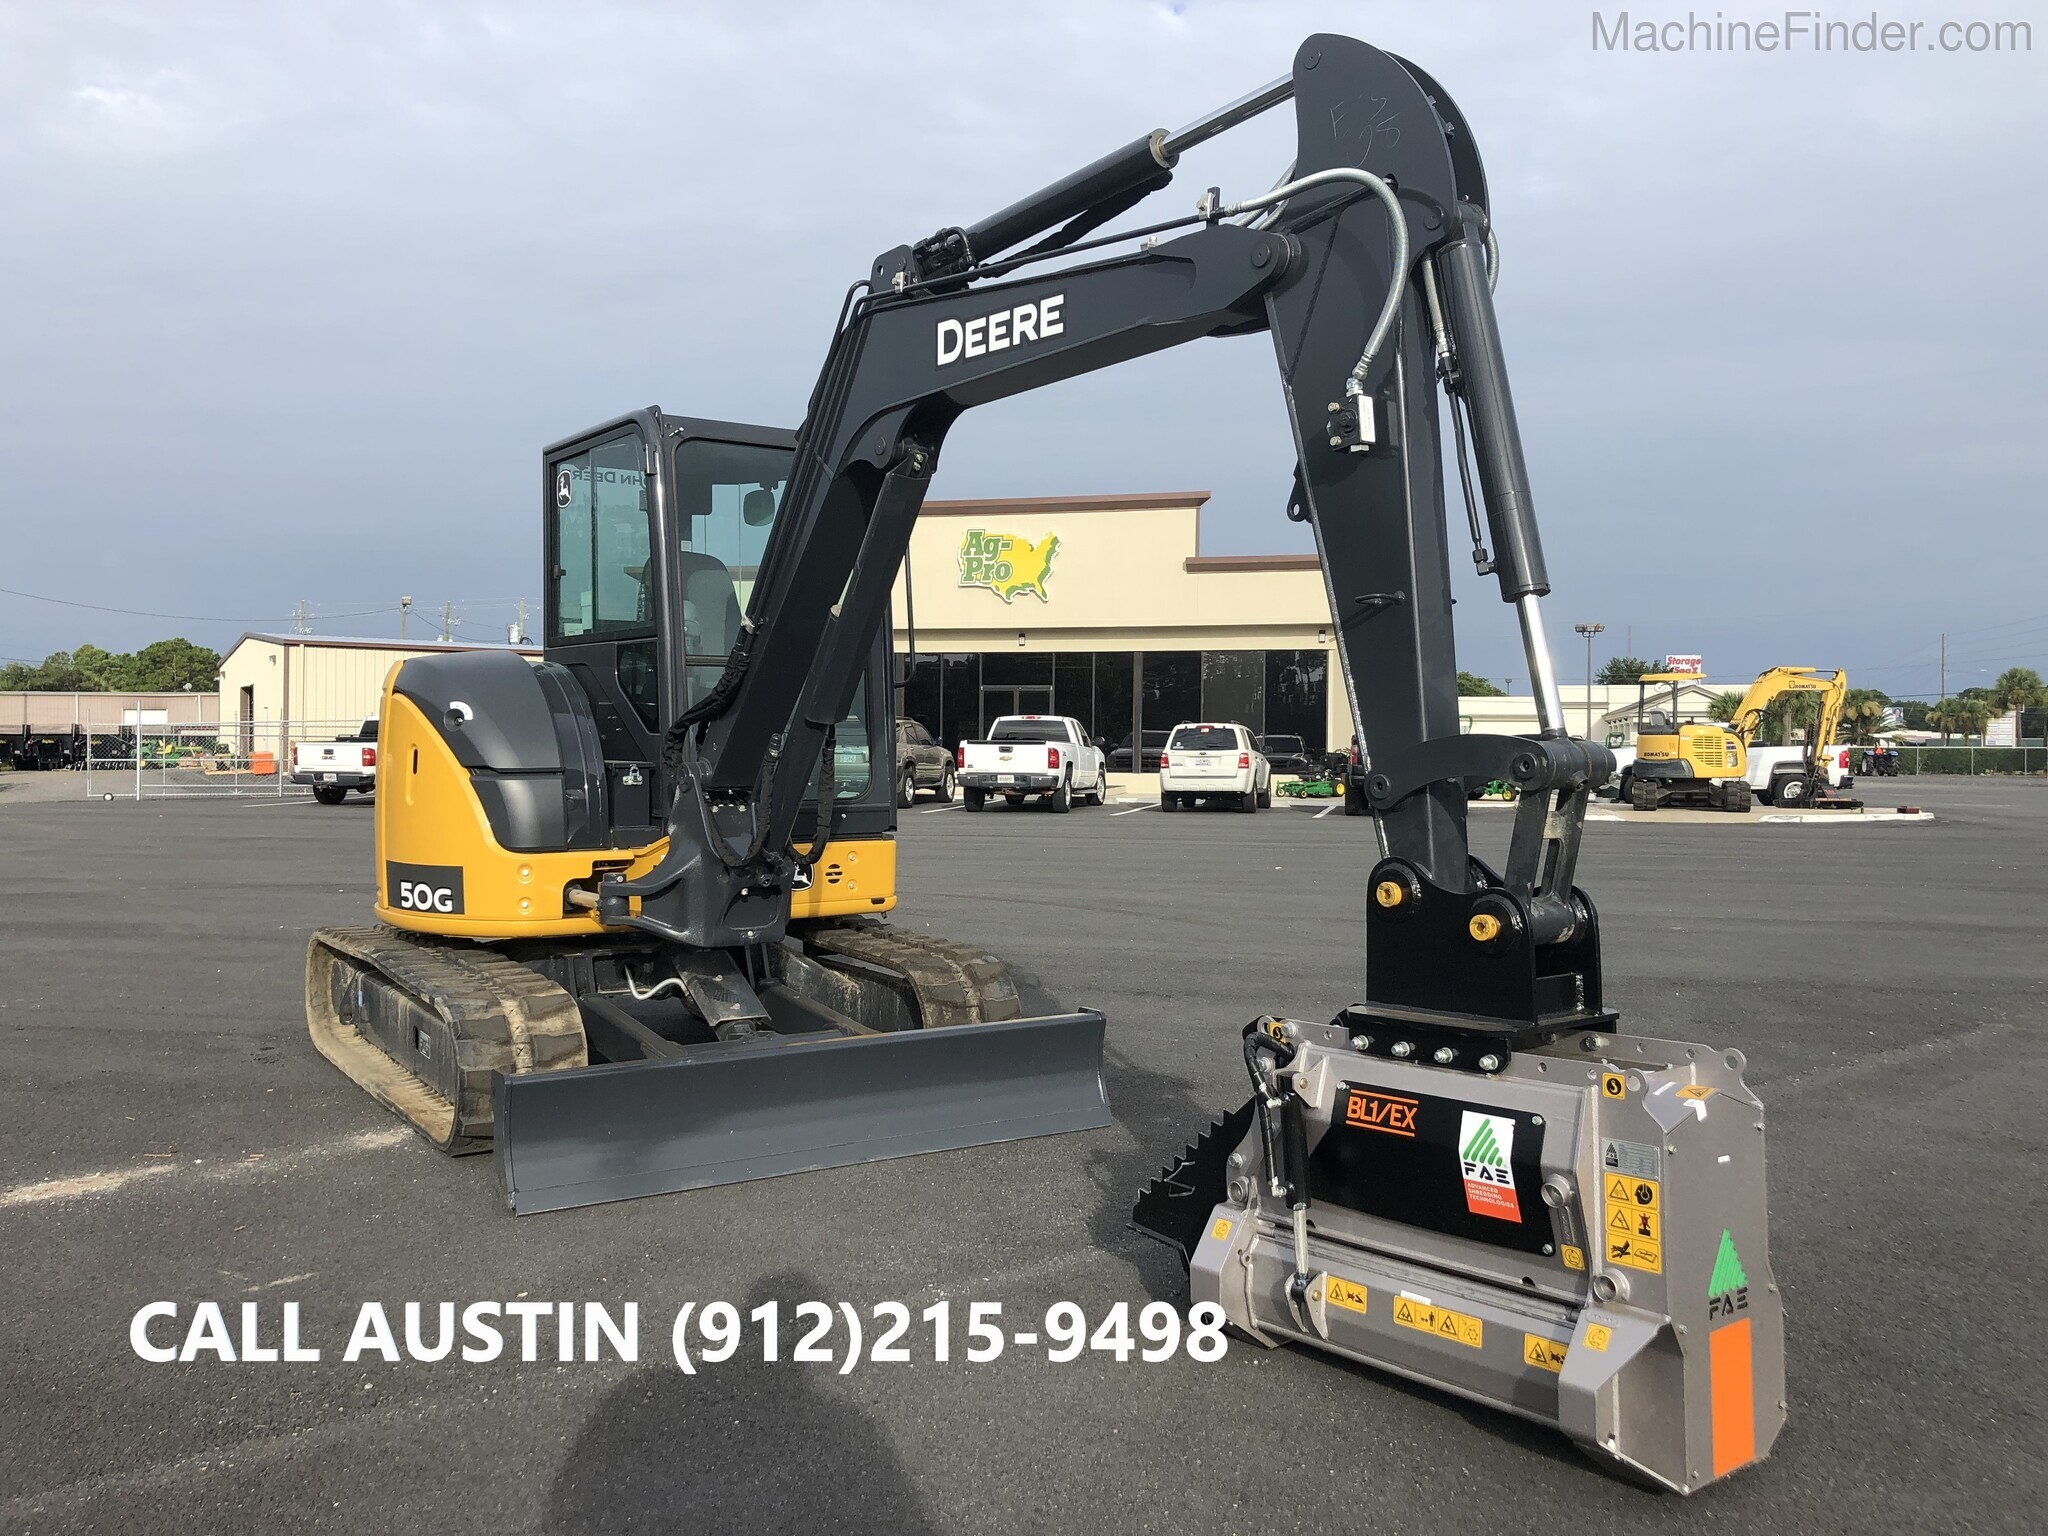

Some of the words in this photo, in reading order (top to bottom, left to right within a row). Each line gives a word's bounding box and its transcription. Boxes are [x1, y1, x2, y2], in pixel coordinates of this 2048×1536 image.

[937, 293, 1065, 366] DEERE
[962, 529, 1012, 561] Ag-
[961, 556, 1012, 583] Pro
[1667, 656, 1702, 667] Storage
[400, 881, 453, 912] 50G
[1347, 1096, 1418, 1130] BL1/EX
[1463, 1162, 1510, 1185] FAE
[1467, 1182, 1499, 1194] ADVANCED
[1468, 1188, 1503, 1200] SHREDDING
[1469, 1194, 1515, 1208] TECHNOLOGIES
[1709, 1286, 1748, 1321] FAE
